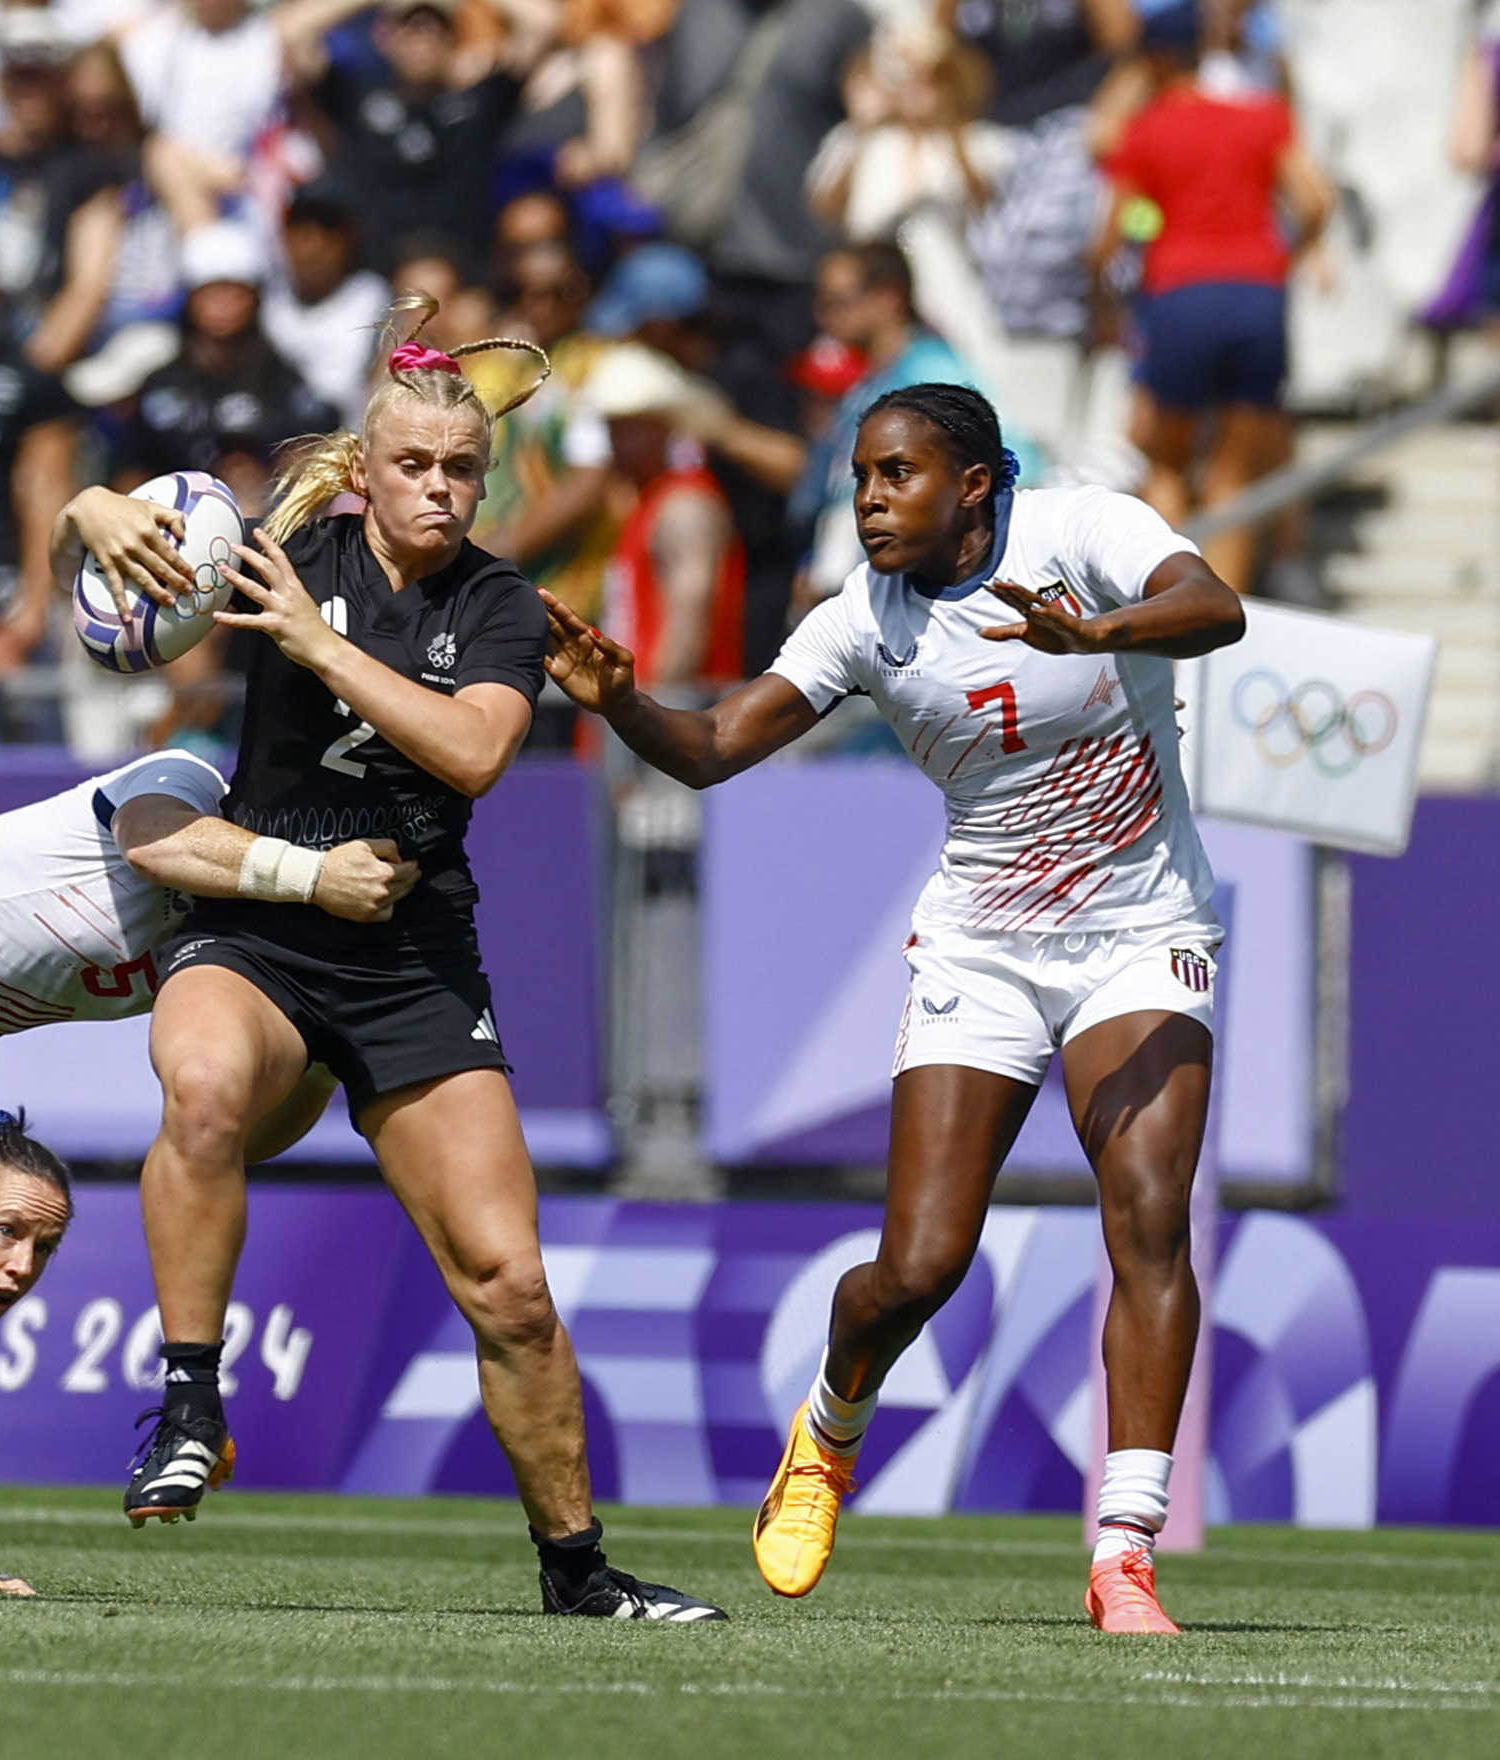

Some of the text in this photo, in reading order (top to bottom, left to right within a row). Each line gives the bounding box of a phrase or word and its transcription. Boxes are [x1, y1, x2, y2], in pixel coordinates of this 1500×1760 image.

[1041, 587, 1060, 602] SA
[320, 698, 377, 779] 2
[965, 681, 1028, 755] 7
[80, 949, 159, 997] 5
[1178, 950, 1200, 965] USA
